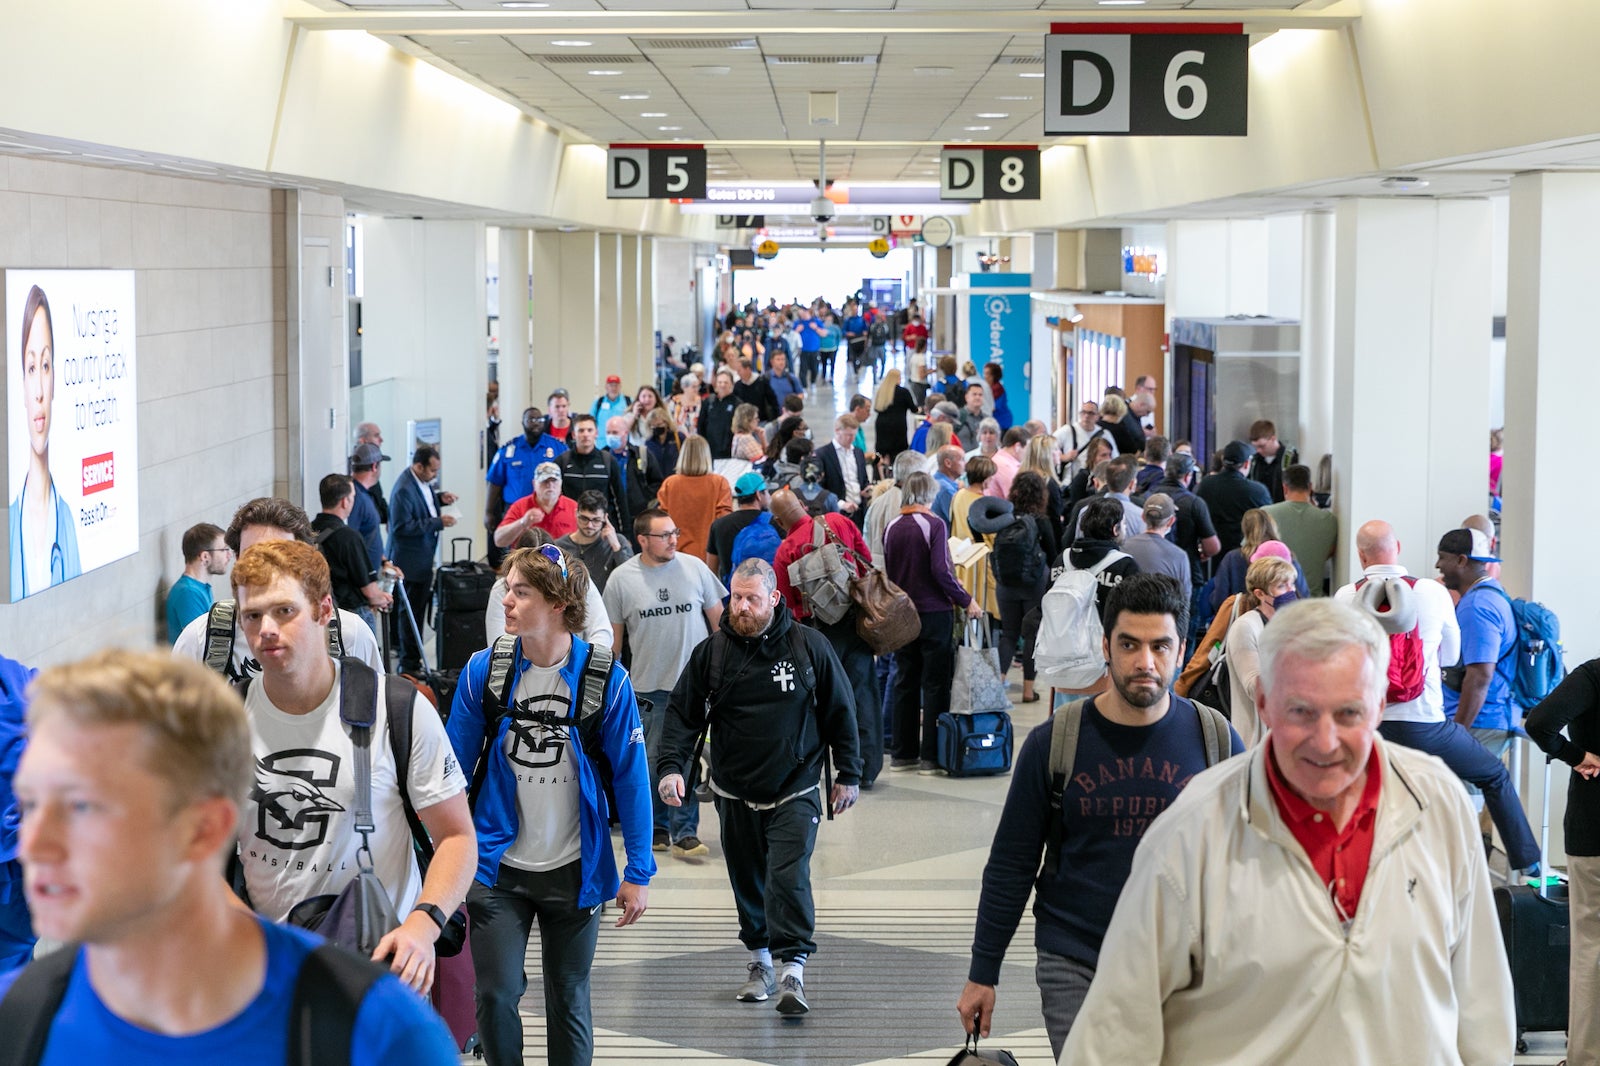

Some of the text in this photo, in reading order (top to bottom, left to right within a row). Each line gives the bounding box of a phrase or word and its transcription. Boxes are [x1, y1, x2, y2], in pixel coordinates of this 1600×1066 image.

[1060, 50, 1208, 120] D 6
[614, 156, 690, 193] D 5
[948, 156, 1025, 194] D 8
[73, 303, 111, 344] Nursing
[64, 344, 128, 390] country back
[75, 397, 86, 431] to
[83, 459, 114, 489] SERVICE
[639, 603, 693, 619] HARD NO
[517, 773, 577, 784] SEBALL
[1080, 797, 1167, 817] REPUB
[1112, 818, 1154, 836] 197
